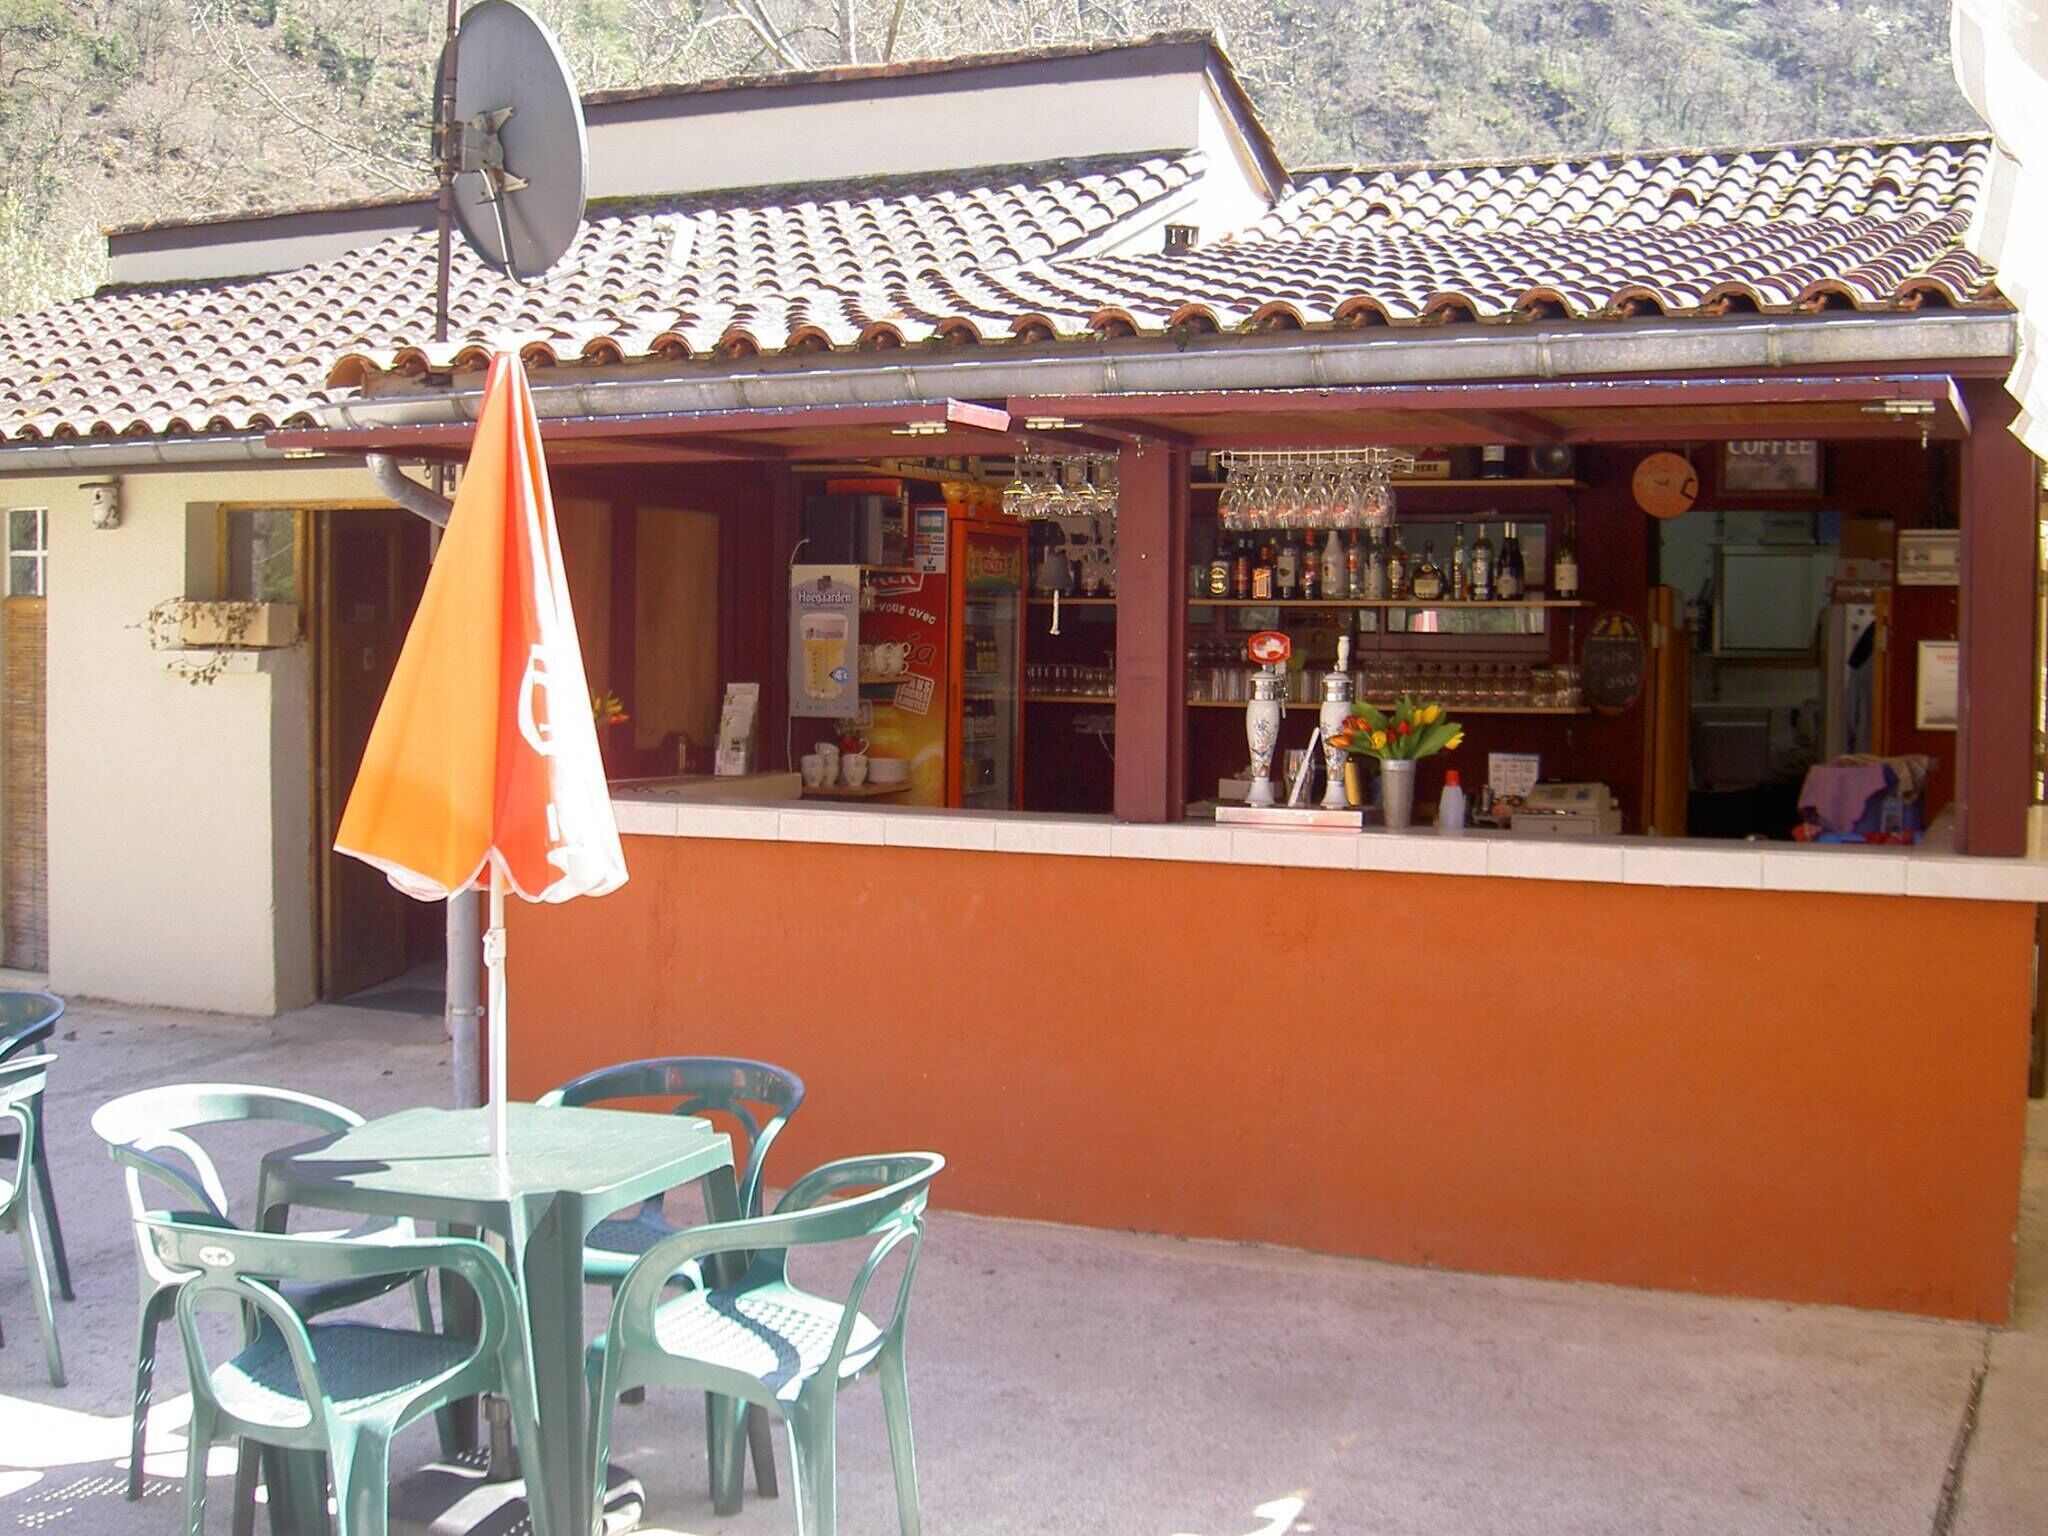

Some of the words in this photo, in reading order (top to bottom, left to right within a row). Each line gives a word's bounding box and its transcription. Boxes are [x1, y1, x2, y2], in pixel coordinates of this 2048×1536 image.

[1727, 440, 1814, 455] COFFEE
[797, 590, 852, 605] Hoegaarden
[908, 607, 936, 625] avec
